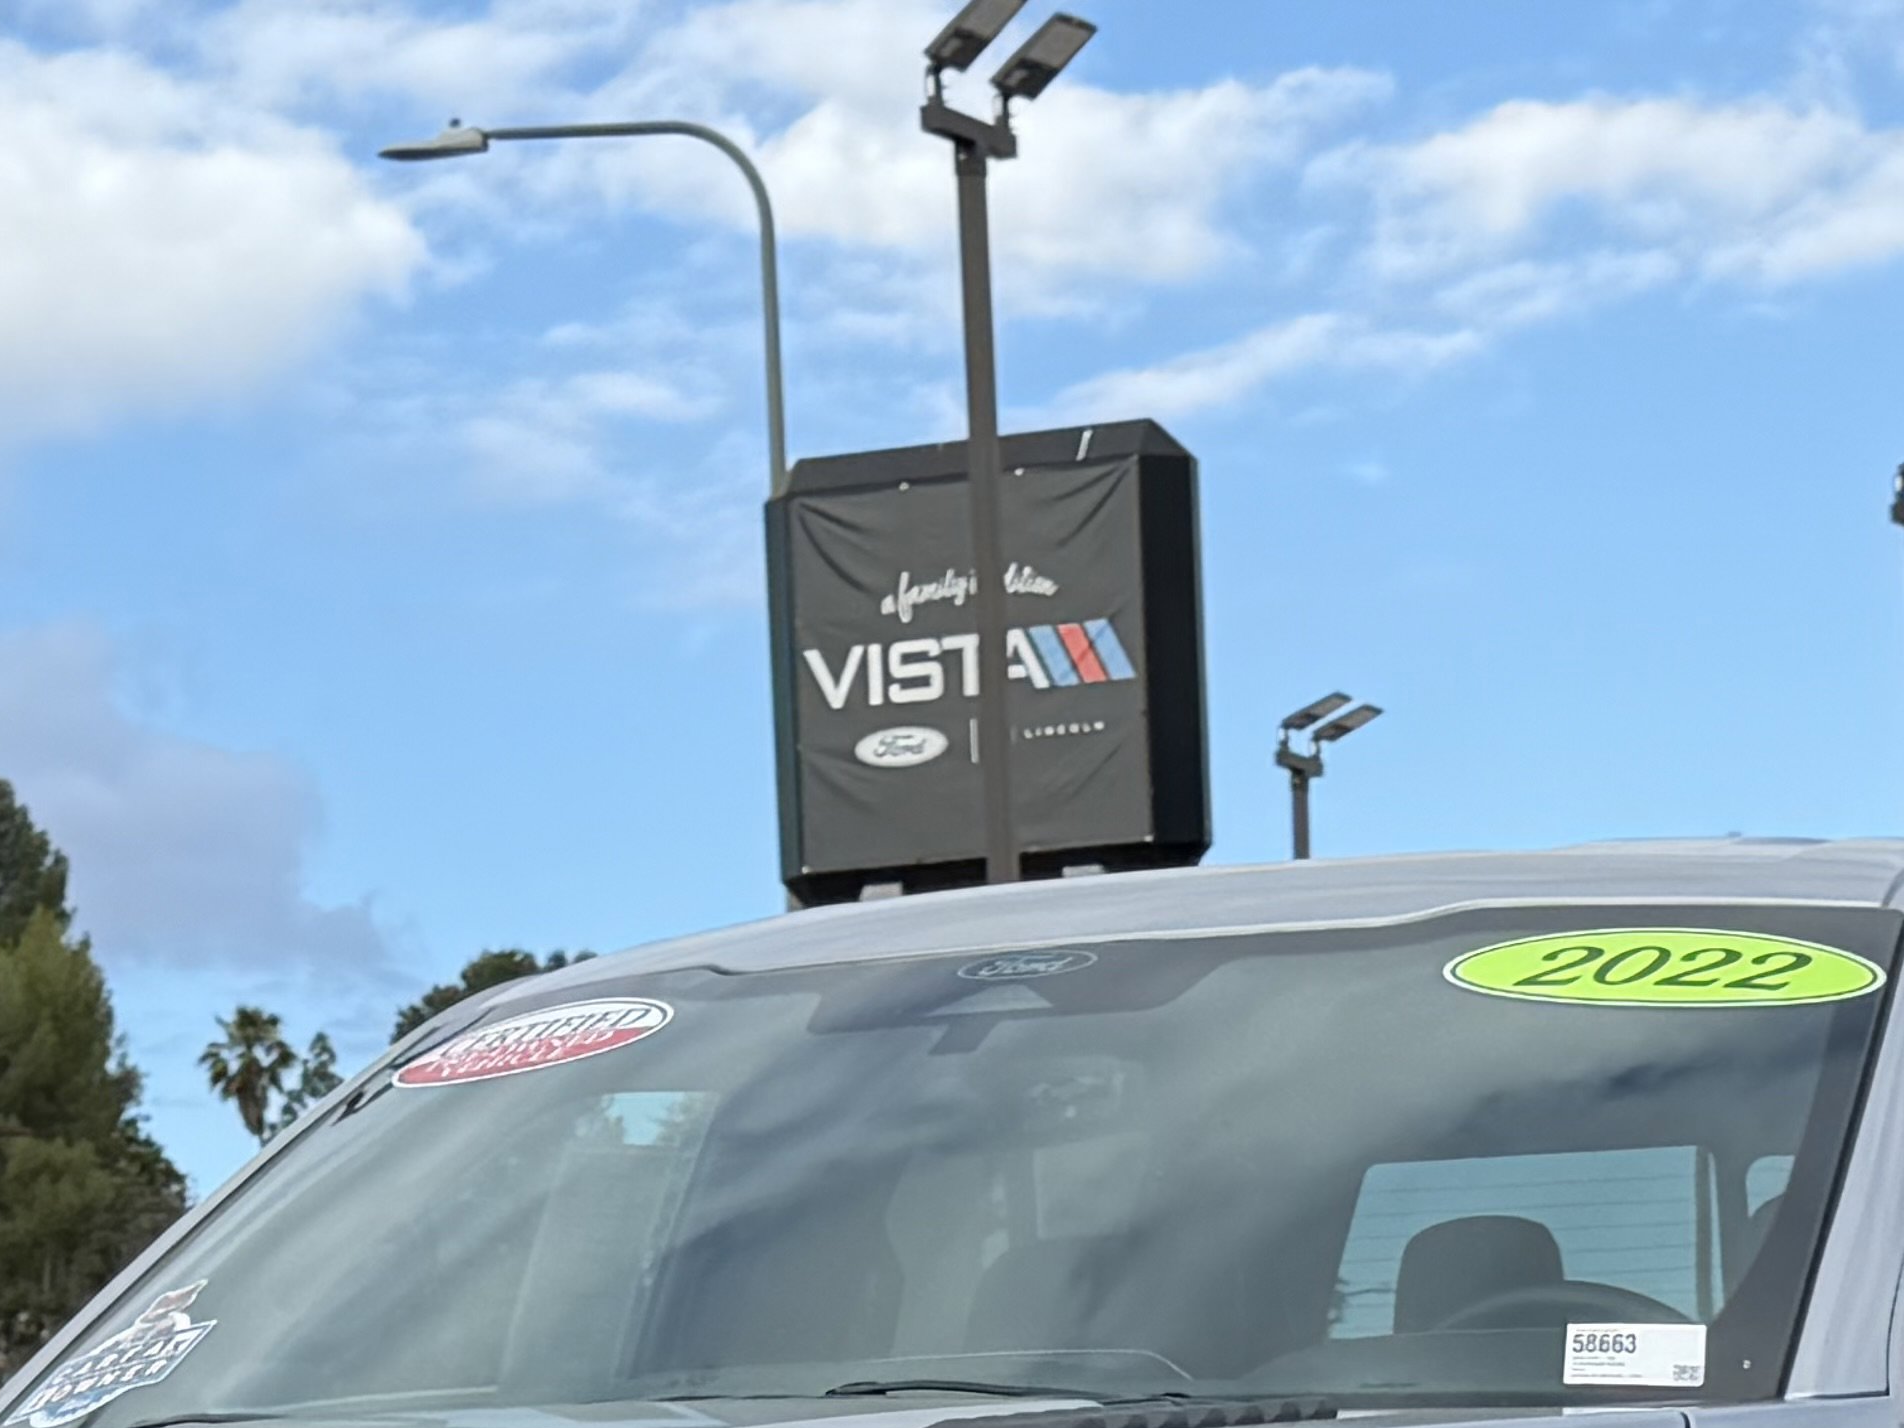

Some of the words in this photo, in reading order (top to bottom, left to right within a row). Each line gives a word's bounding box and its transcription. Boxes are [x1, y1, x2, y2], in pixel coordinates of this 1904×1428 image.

[803, 627, 1050, 710] VISTA
[1512, 945, 1813, 991] 2022
[1572, 1333, 1637, 1354] 58663
